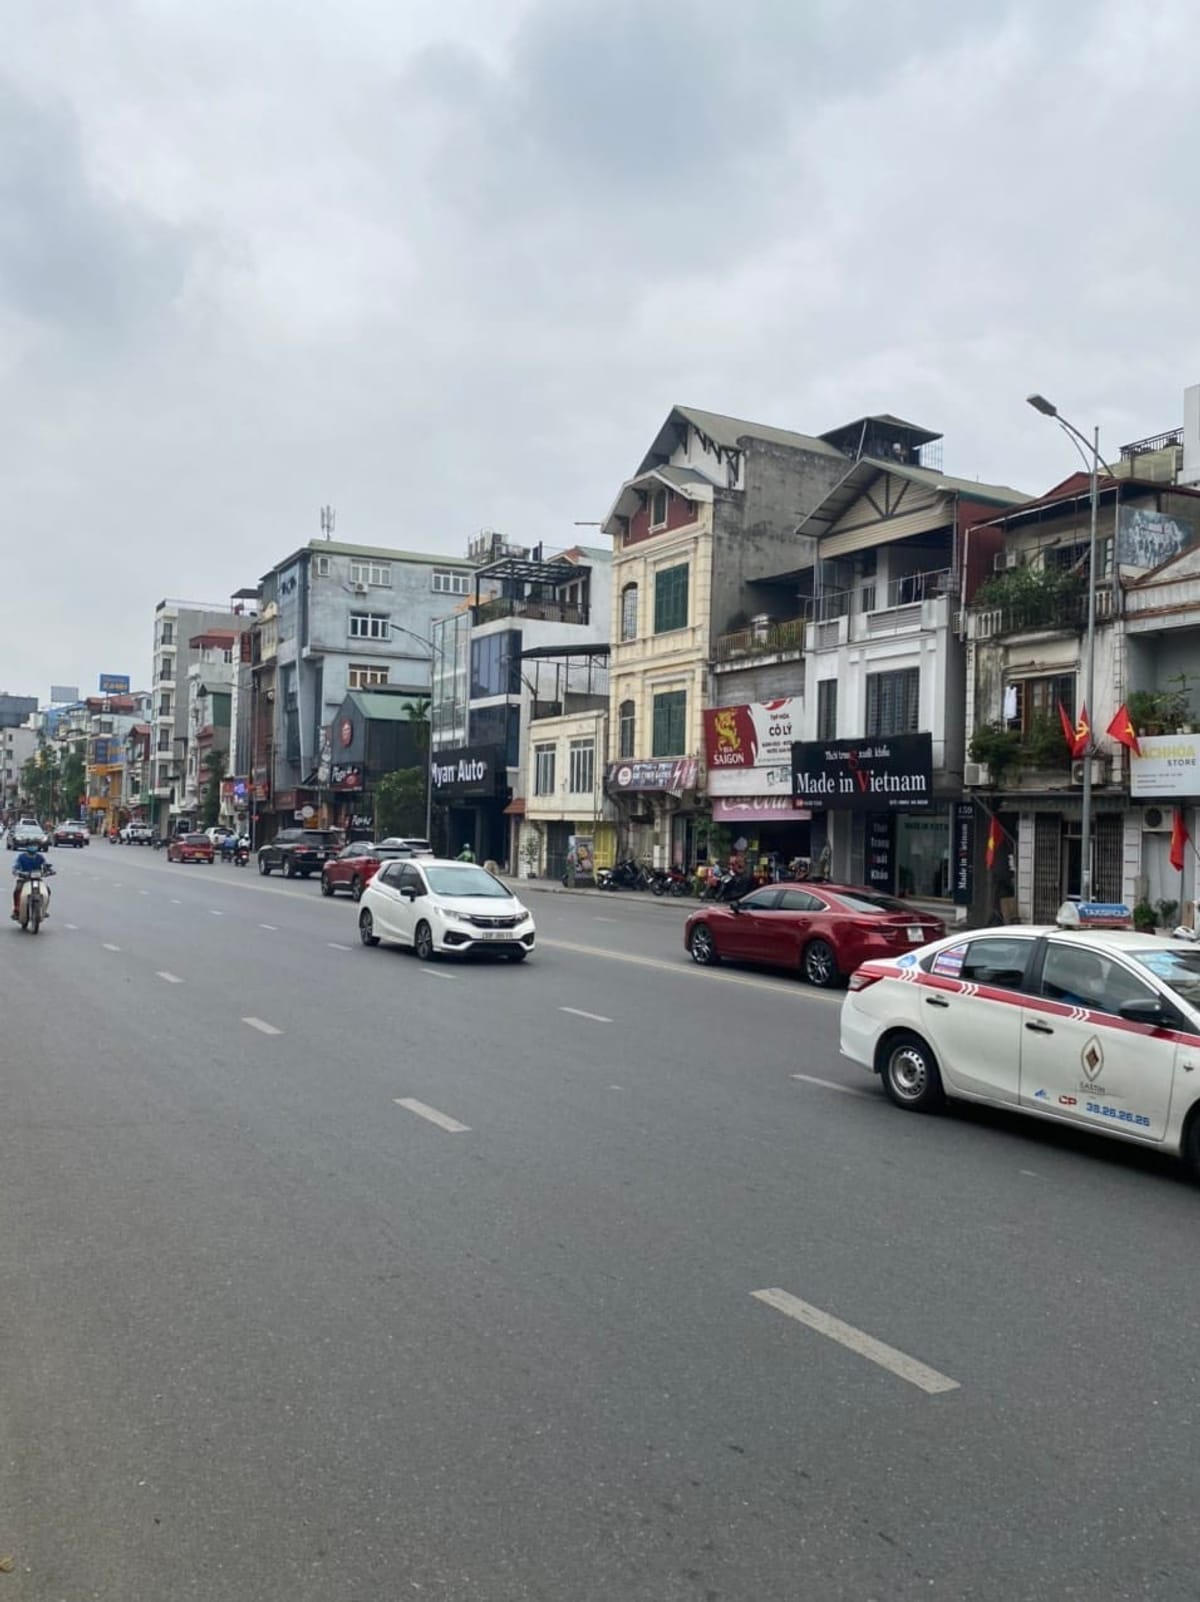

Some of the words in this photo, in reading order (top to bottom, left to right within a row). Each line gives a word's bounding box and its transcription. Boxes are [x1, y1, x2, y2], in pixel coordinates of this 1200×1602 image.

[769, 723, 782, 736] CÔ
[1167, 758, 1197, 767] STORE
[457, 758, 484, 782] Auto
[797, 771, 836, 794] Made
[839, 770, 854, 793] in
[856, 768, 926, 795] Vietnam
[1058, 1095, 1077, 1105] CP
